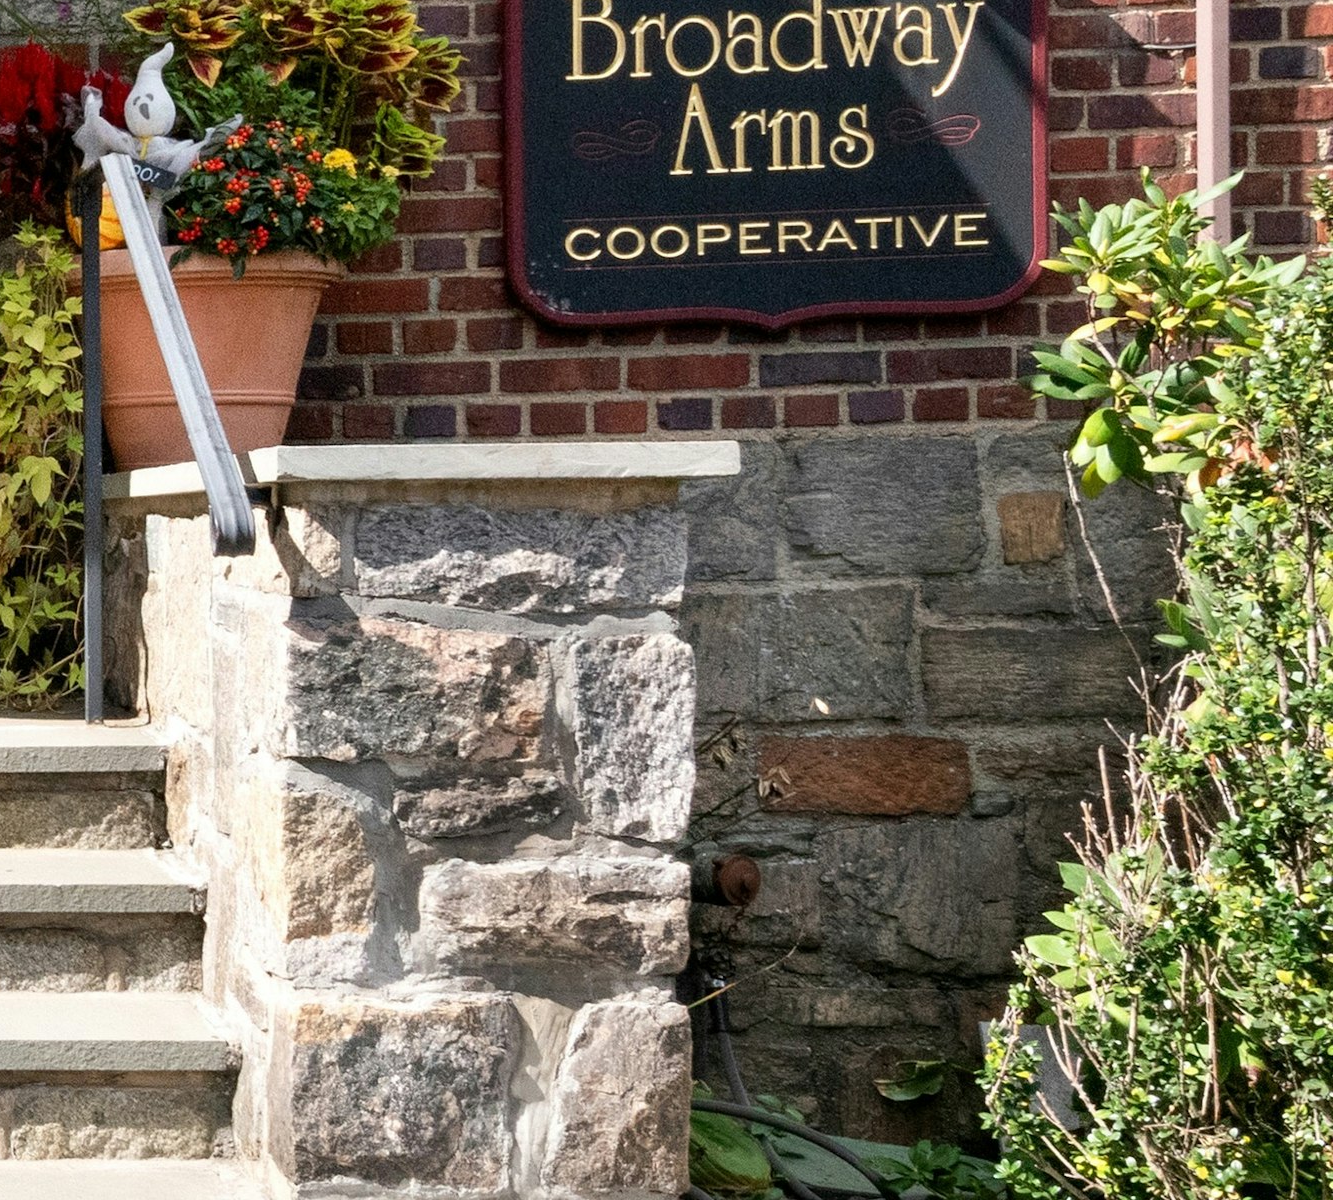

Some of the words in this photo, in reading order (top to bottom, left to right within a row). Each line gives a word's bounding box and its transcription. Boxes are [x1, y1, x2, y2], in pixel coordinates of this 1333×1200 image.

[669, 82, 874, 176] Arms
[133, 164, 161, 183] OO!
[564, 212, 989, 262] COOPERATIVE
